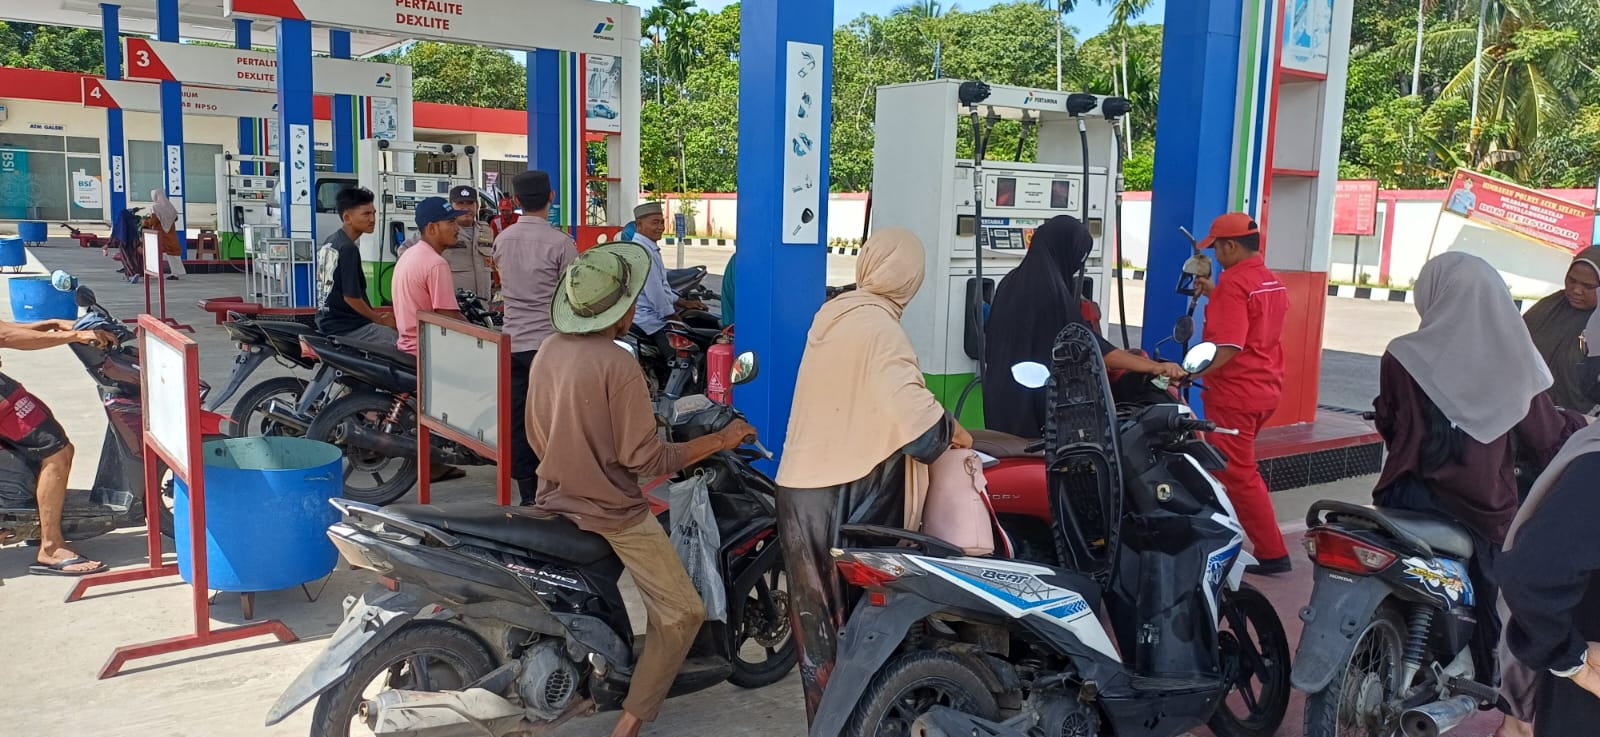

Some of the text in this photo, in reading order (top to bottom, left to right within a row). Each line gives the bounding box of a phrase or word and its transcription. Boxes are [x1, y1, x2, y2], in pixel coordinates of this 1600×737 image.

[395, 0, 462, 15] PERTALITE
[396, 13, 449, 30] DEXLITE
[136, 50, 150, 67] 3
[236, 57, 277, 67] PERTALIT
[237, 71, 275, 81] DEXLITE
[90, 86, 101, 99] 4
[2, 152, 15, 172] BSI
